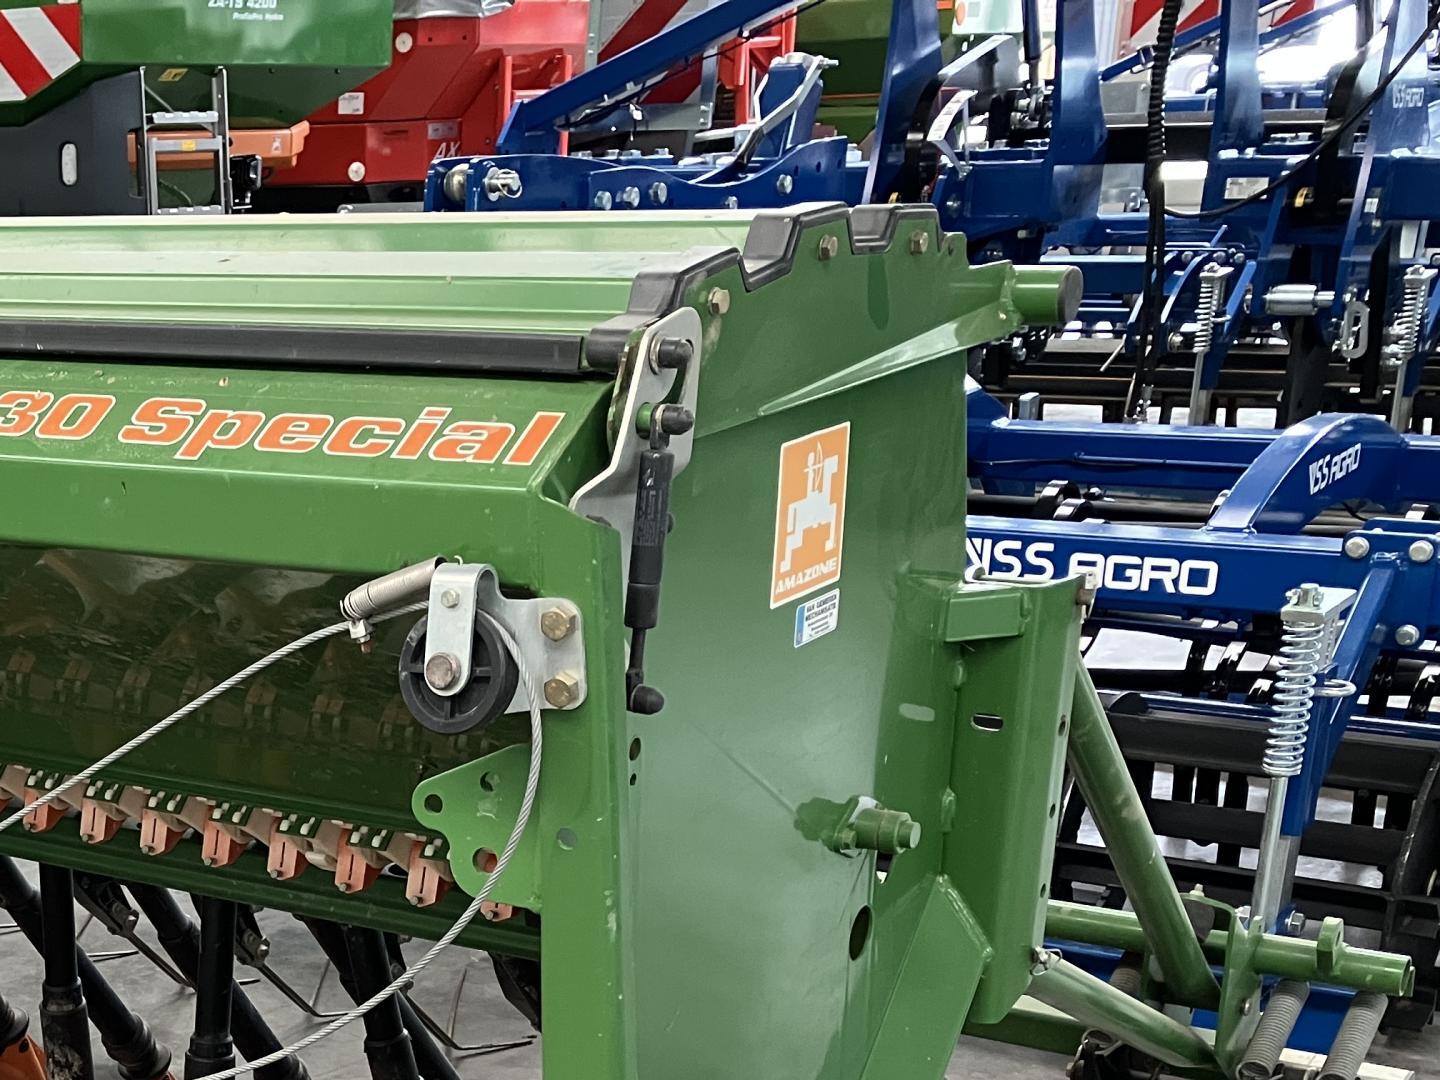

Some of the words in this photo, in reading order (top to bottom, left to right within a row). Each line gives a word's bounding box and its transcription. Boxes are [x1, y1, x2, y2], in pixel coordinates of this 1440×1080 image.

[117, 396, 566, 466] Special
[1329, 443, 1361, 485] AGRO
[775, 556, 838, 594] AMAZONE
[1068, 551, 1219, 597] AGRO
